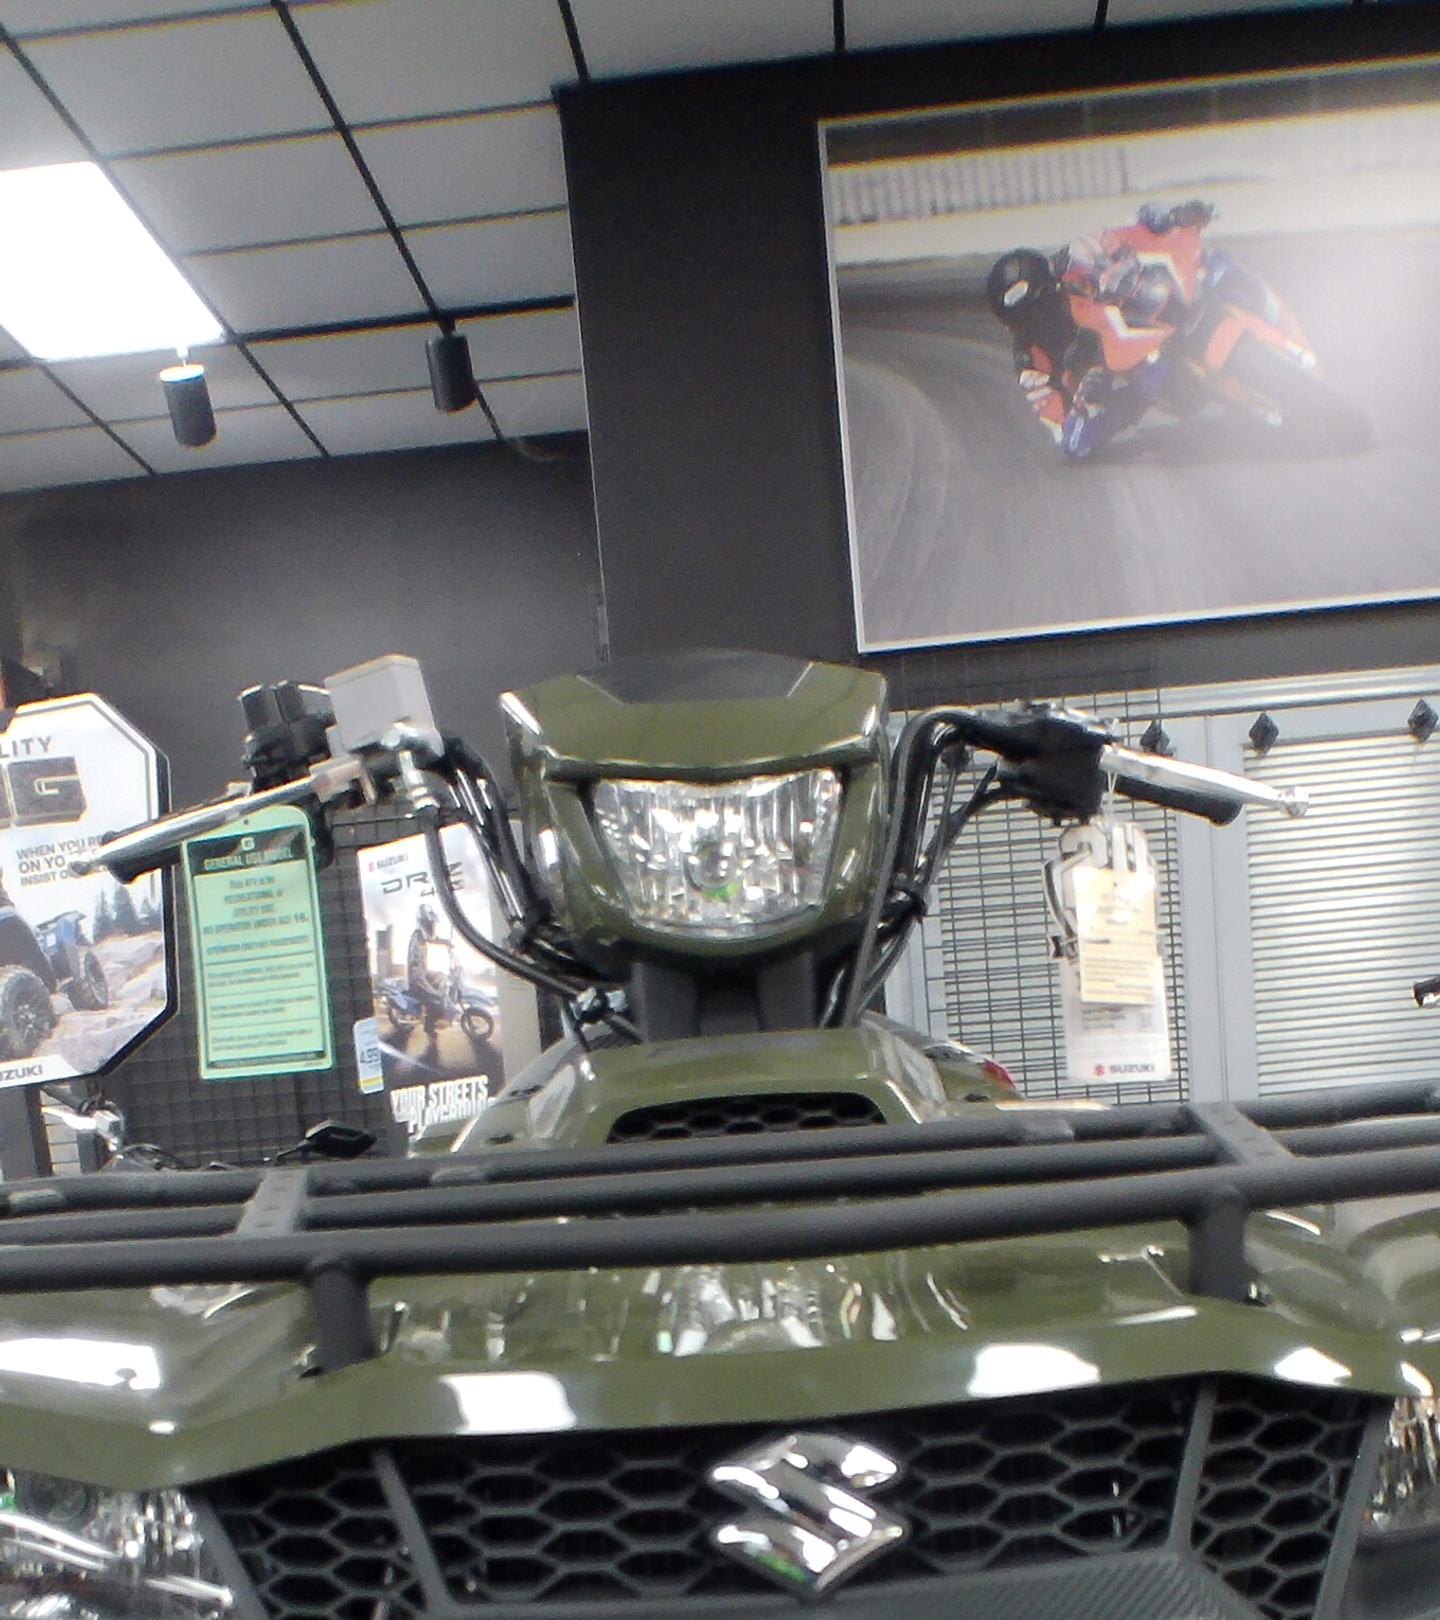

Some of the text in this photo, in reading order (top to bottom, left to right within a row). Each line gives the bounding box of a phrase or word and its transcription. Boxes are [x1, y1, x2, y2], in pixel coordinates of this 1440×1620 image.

[16, 843, 56, 860] WHEN
[18, 859, 41, 874] ON
[20, 871, 57, 887] INSIST
[1109, 1062, 1156, 1074] SUZUKI
[428, 1074, 489, 1109] STREETS
